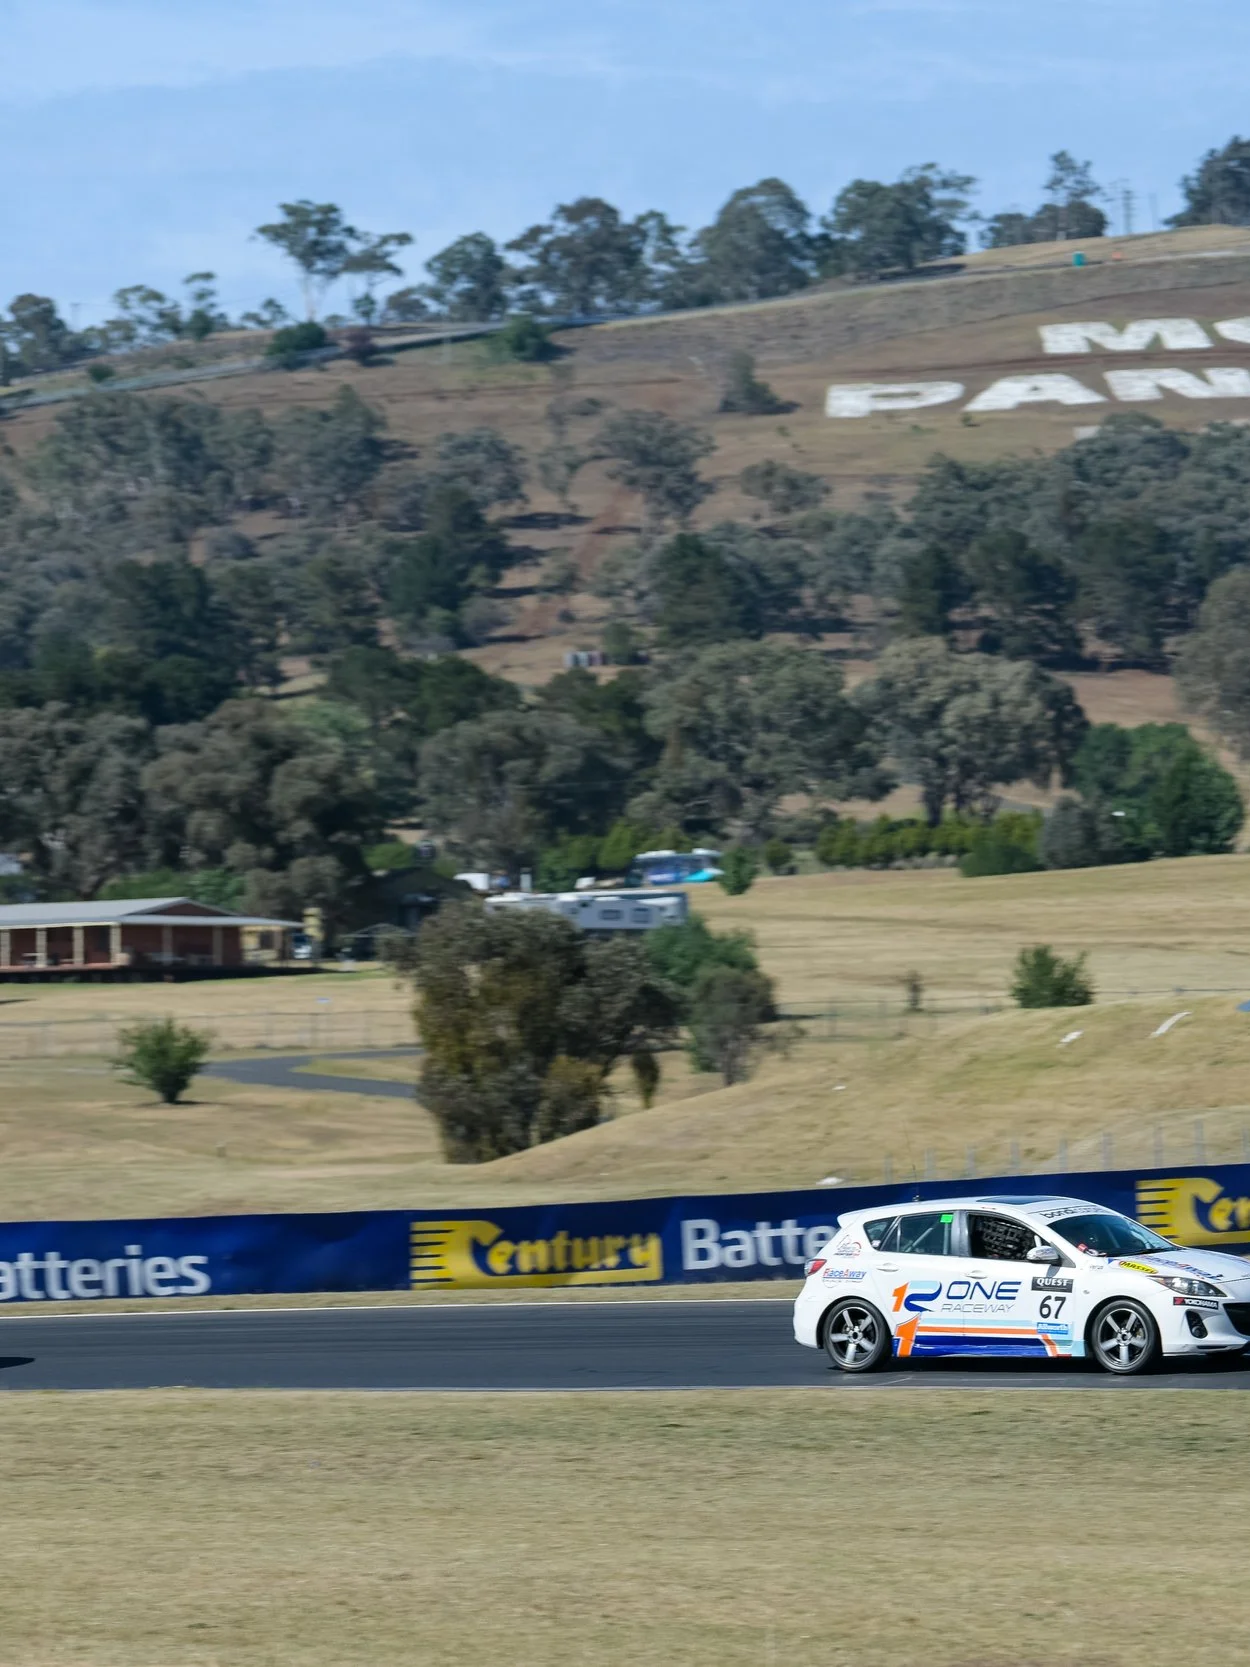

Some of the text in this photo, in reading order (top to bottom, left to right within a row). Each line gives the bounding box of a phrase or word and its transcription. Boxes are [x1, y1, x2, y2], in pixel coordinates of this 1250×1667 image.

[410, 1218, 838, 1290] Century Batte
[0, 1244, 211, 1300] atteries
[1036, 1277, 1070, 1287] QUEST
[946, 1280, 1022, 1301] ONE
[940, 1303, 1015, 1313] RACEWAY
[1039, 1295, 1067, 1320] 67
